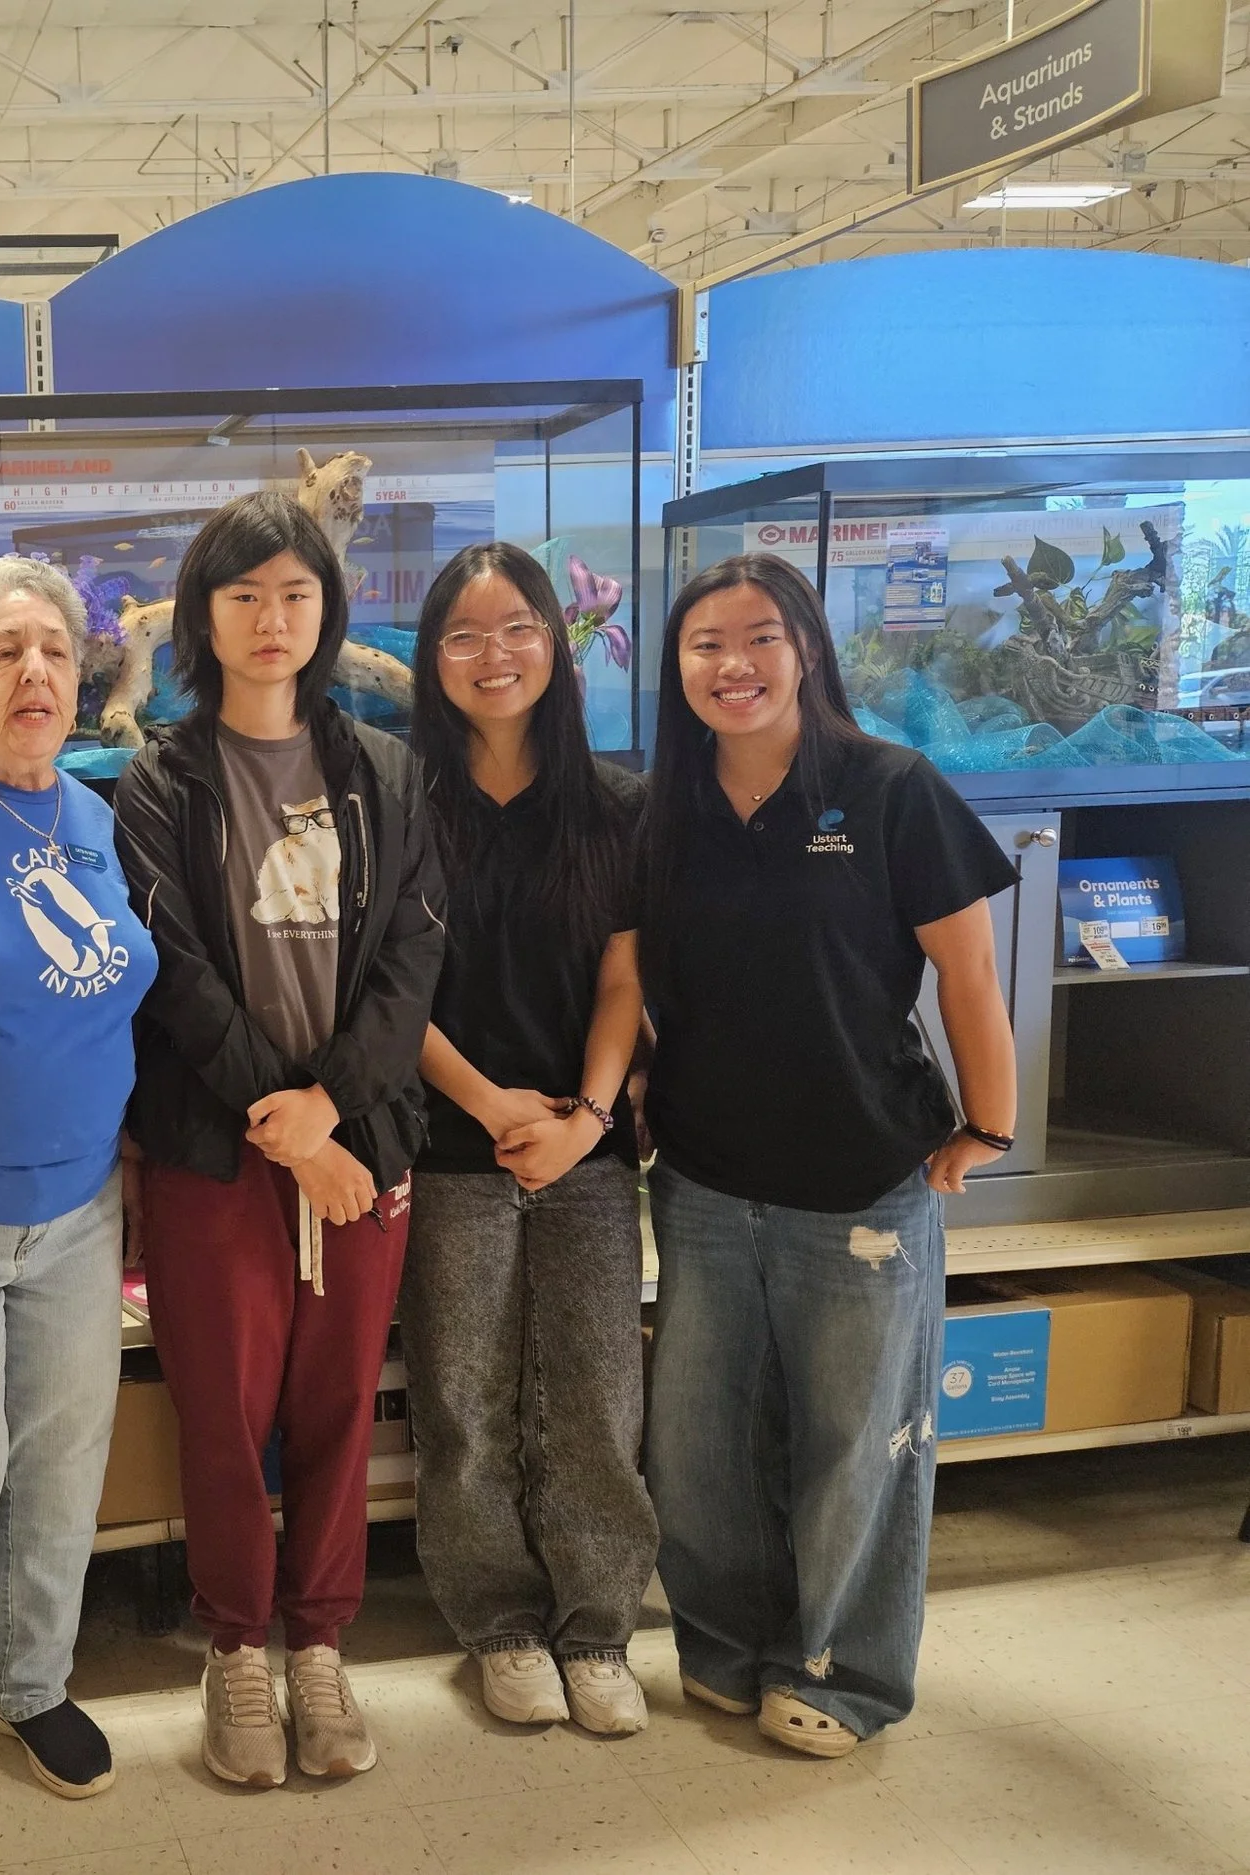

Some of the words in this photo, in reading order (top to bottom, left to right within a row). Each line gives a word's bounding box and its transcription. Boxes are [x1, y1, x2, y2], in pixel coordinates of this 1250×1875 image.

[979, 42, 1092, 110] Aquariums
[990, 115, 1007, 140] &
[1014, 82, 1083, 131] Stands
[14, 486, 68, 497] HIGH
[91, 482, 235, 496] DEFINITION
[4, 501, 16, 510] 60
[830, 551, 844, 562] 75
[813, 833, 847, 844] Ustart
[806, 842, 854, 854] Teaching
[12, 846, 69, 875] CATS
[1079, 877, 1160, 893] Ornaments
[1093, 894, 1106, 908] &
[1108, 893, 1152, 907] Plants
[38, 964, 69, 994] IN
[70, 945, 129, 998] NEED
[950, 1372, 966, 1384] 37
